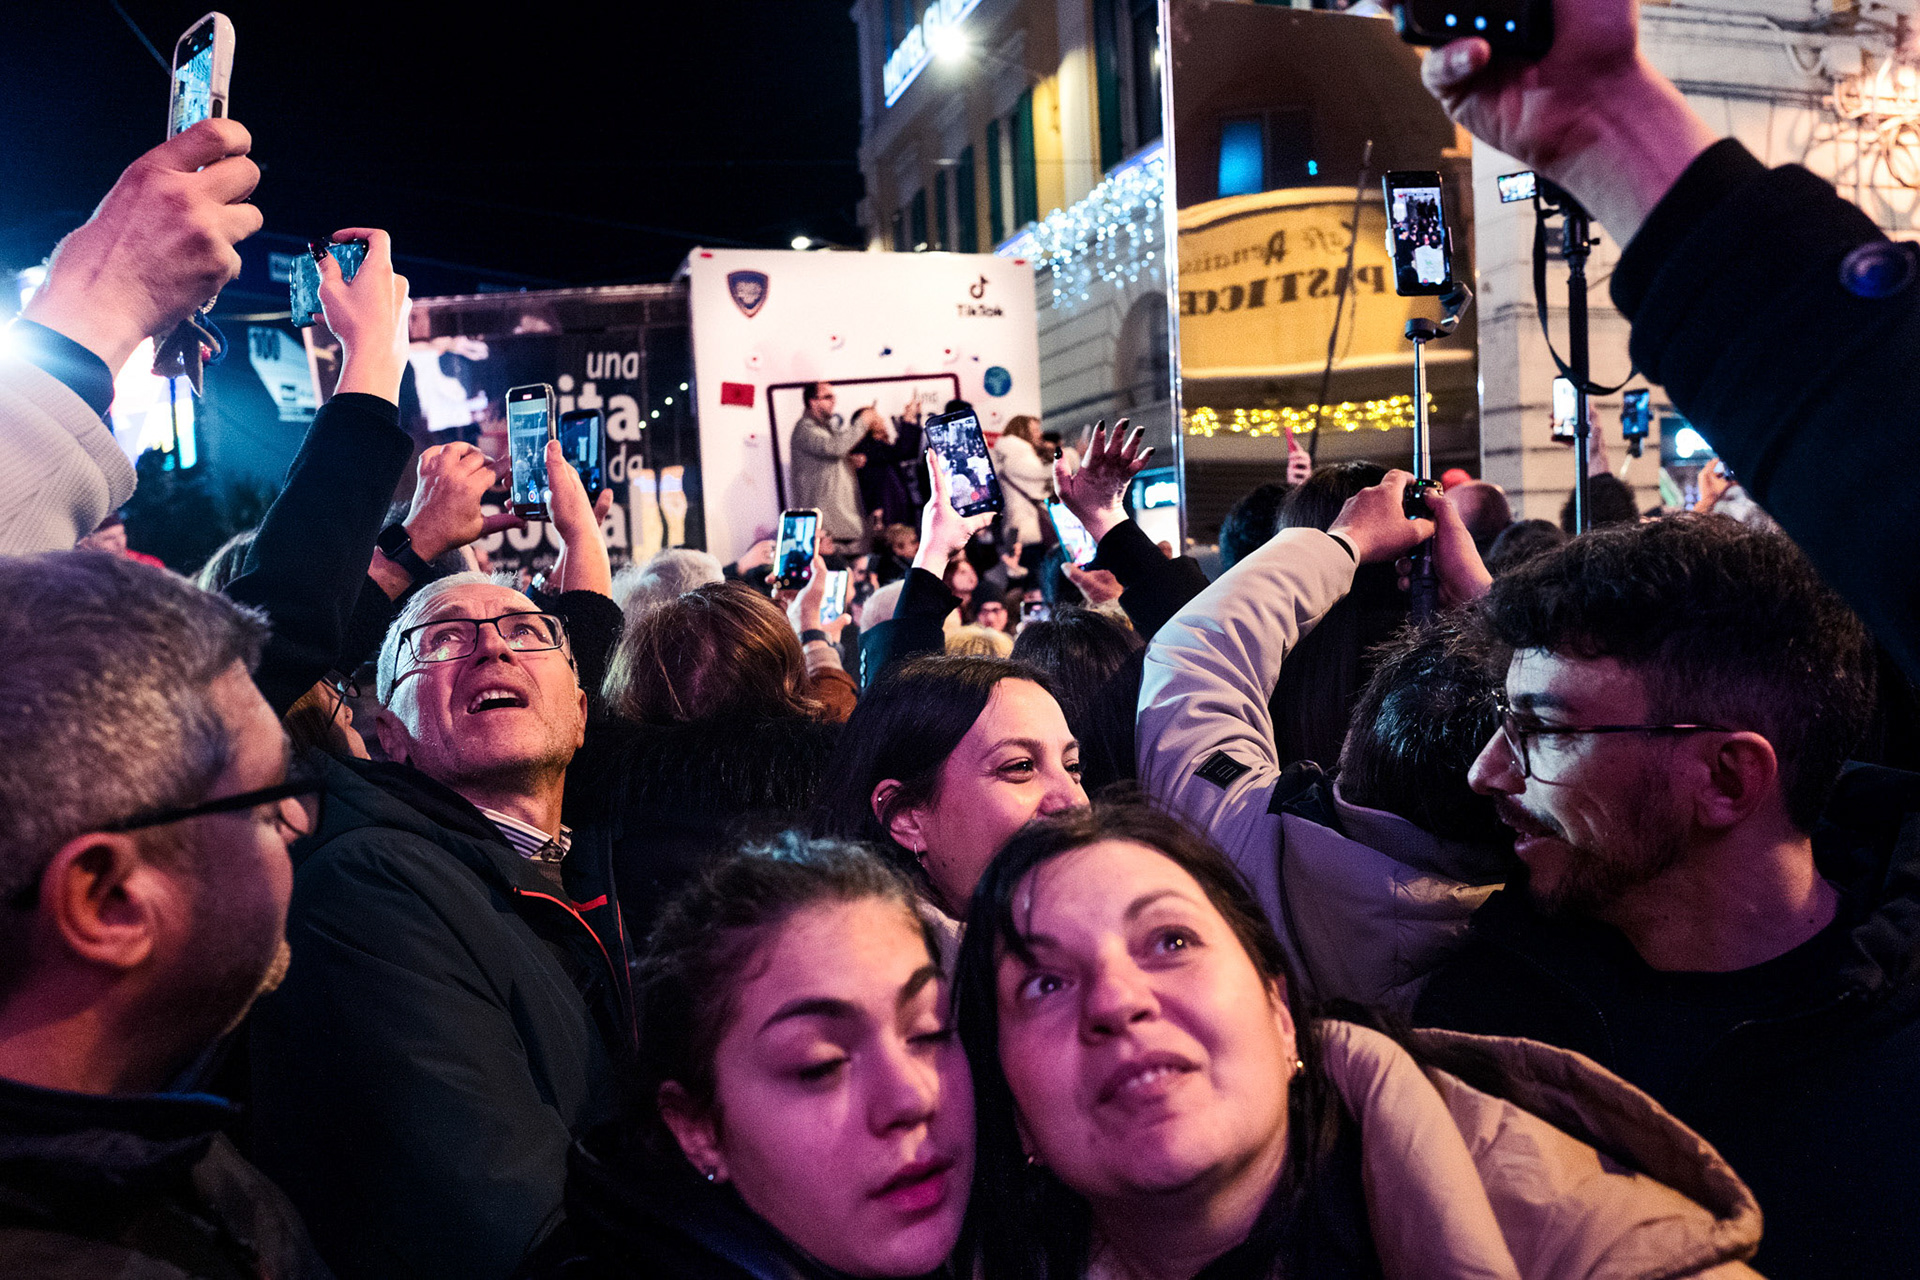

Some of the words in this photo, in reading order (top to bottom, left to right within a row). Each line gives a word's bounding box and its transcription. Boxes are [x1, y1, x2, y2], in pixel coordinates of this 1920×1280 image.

[957, 303, 1004, 318] TikTok
[586, 351, 640, 380] una
[557, 373, 642, 442] ita
[608, 443, 645, 483] da
